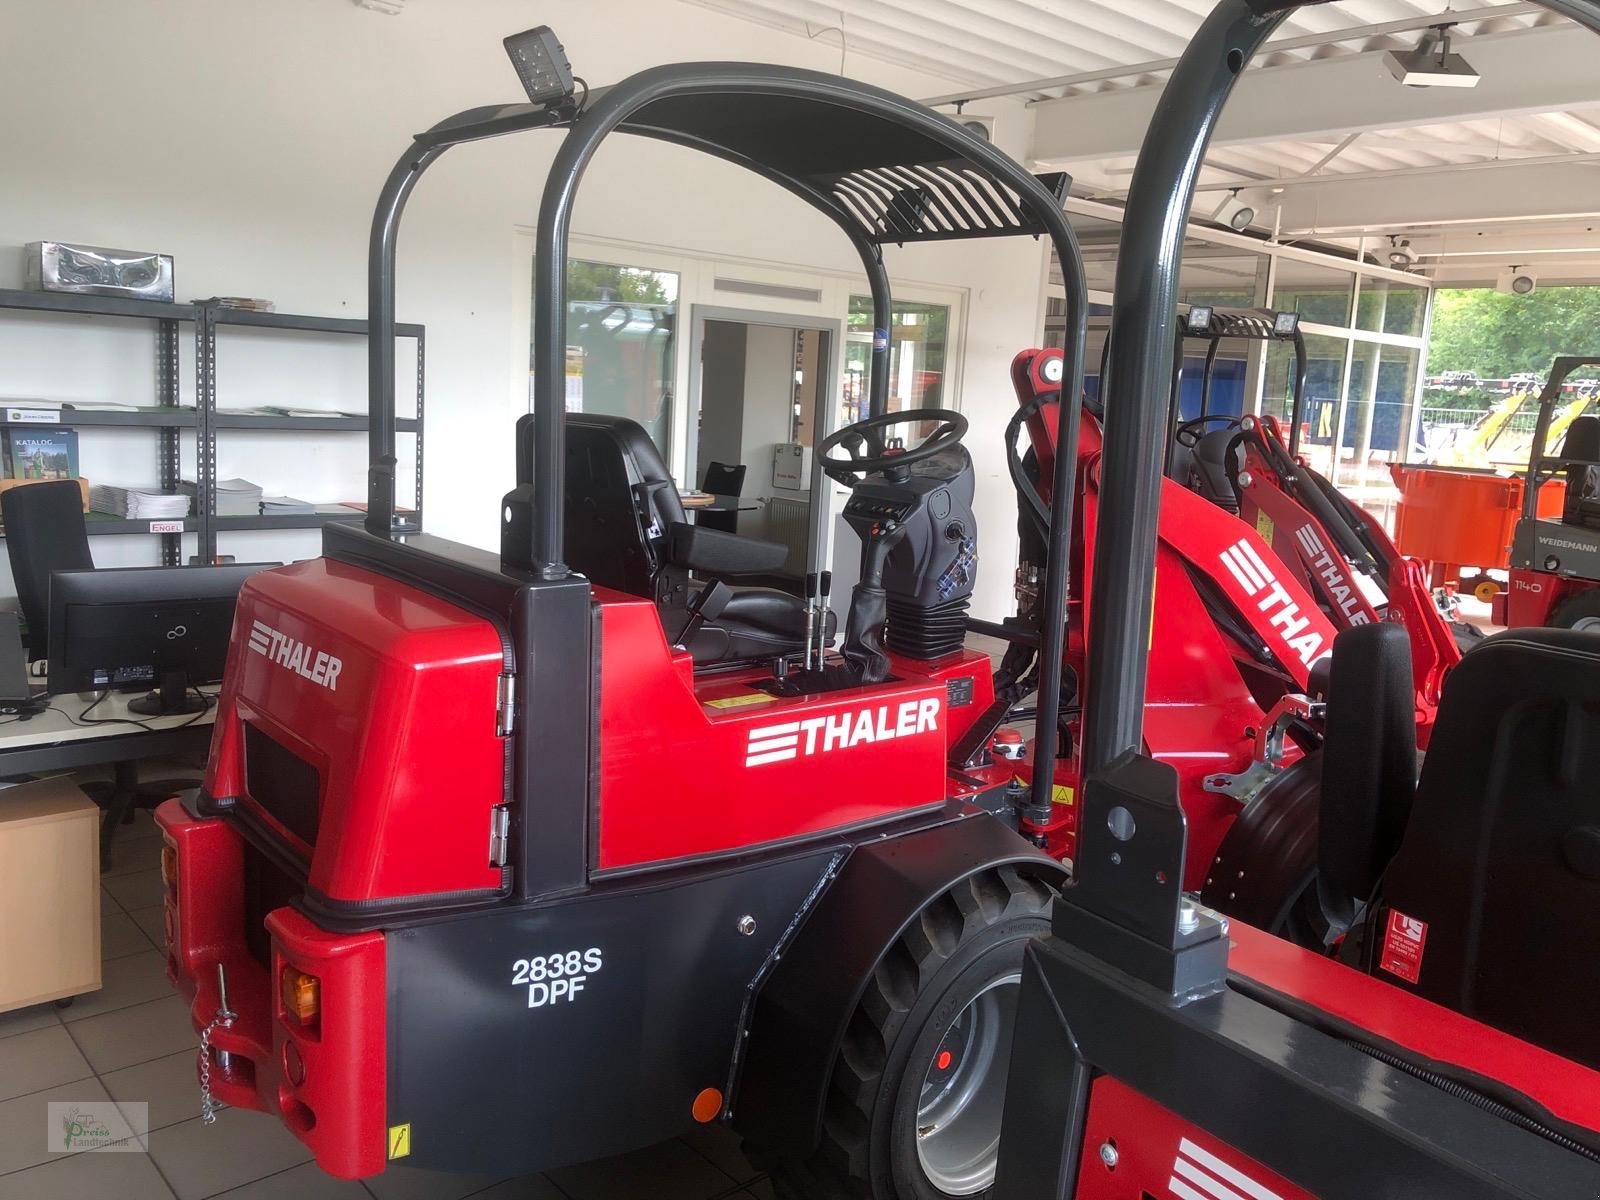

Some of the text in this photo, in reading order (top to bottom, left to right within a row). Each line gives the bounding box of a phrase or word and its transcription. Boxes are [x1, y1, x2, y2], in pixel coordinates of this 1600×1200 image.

[152, 523, 180, 532] ENGEL
[1538, 536, 1598, 553] WEIDEMANN
[1314, 550, 1370, 627] THALE
[1515, 580, 1542, 593] 1140
[1257, 579, 1333, 672] THA
[268, 629, 343, 692] THALER
[800, 697, 941, 757] THALER
[511, 947, 603, 986] 2838S
[527, 975, 587, 1009] DPF
